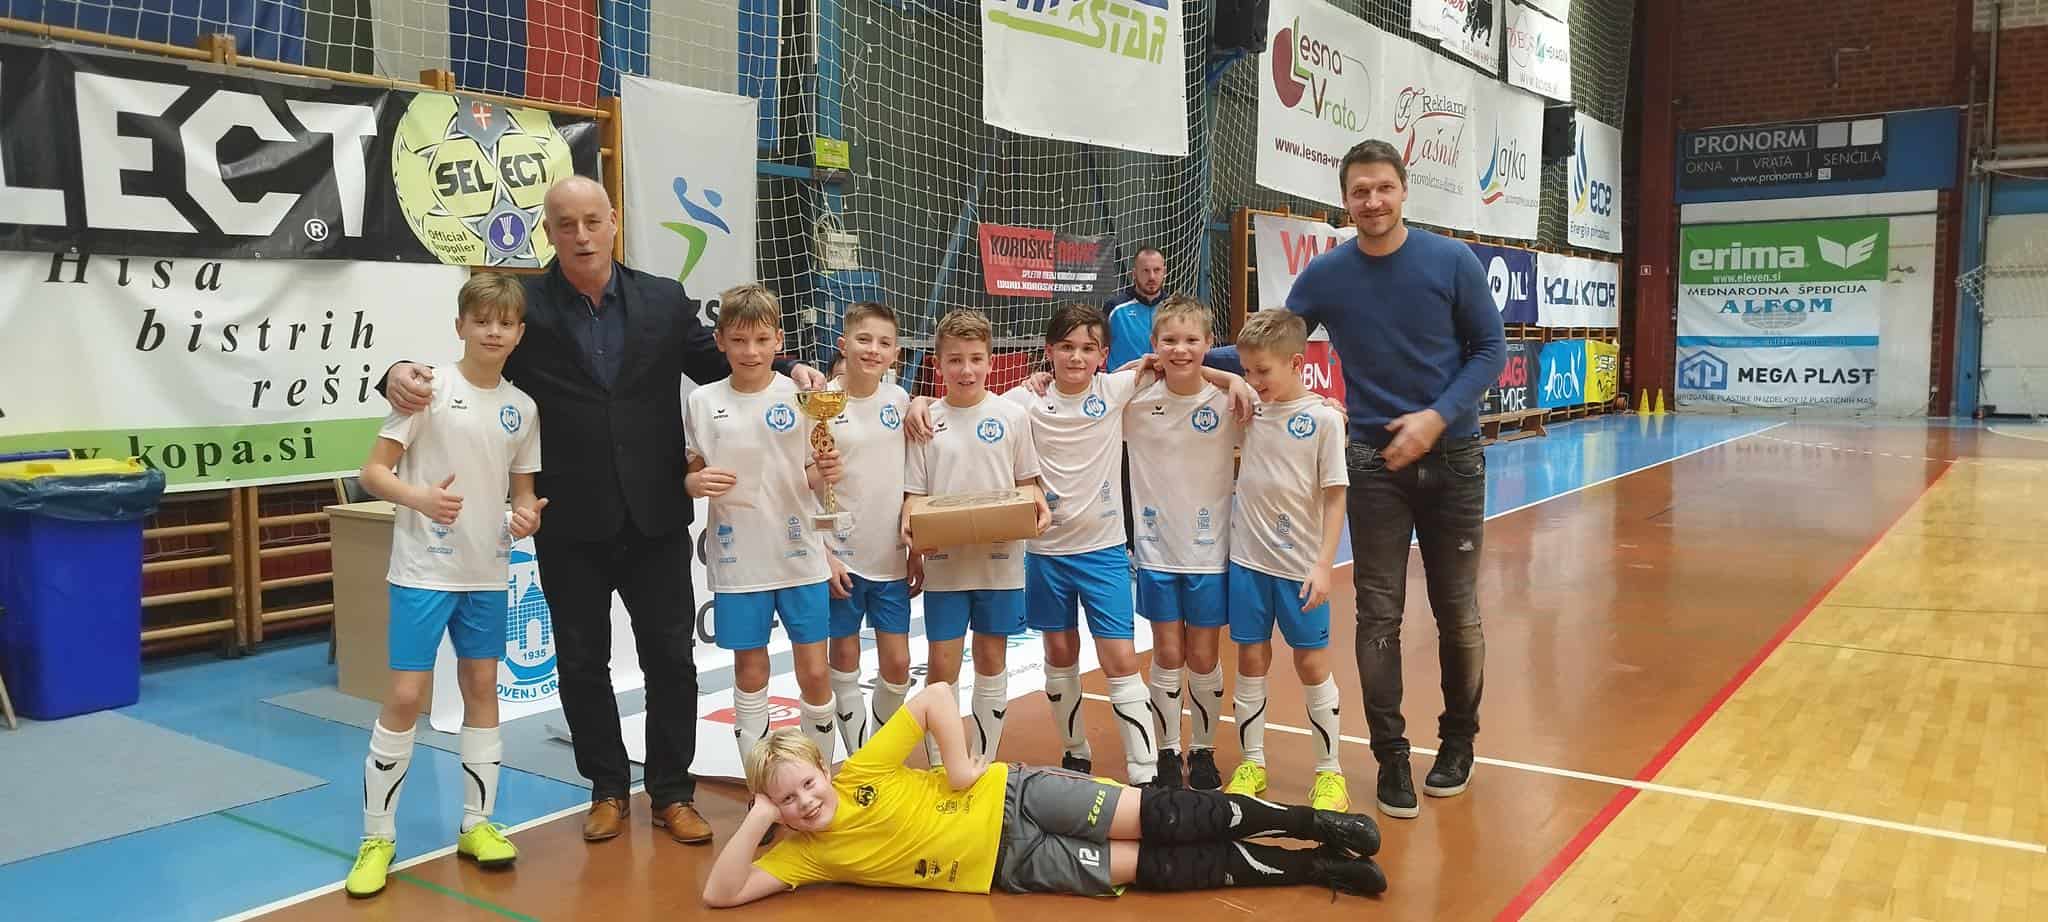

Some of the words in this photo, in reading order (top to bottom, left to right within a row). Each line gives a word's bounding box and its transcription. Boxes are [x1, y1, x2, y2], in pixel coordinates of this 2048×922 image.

[1294, 15, 1342, 76] Lesna
[1310, 72, 1357, 133] Vrata
[1694, 128, 1807, 154] PRONORM
[435, 152, 548, 197] SELECT
[1686, 160, 1723, 175] OKNA
[1753, 155, 1793, 169] VRATA
[1730, 168, 1814, 185] www.pronorm.si
[428, 229, 468, 243] Official
[991, 233, 1054, 261] KOROŠKE
[1688, 242, 1805, 271] erima
[1712, 271, 1782, 284] www.eleven.si
[1687, 286, 1790, 297] MEDNARODNA
[1718, 298, 1833, 314] ALFOM
[135, 308, 375, 352] bistrih
[1738, 367, 1798, 384] MEGA
[1804, 368, 1876, 385] PLAST
[523, 648, 546, 660] 1935
[1078, 847, 1100, 868] 12
